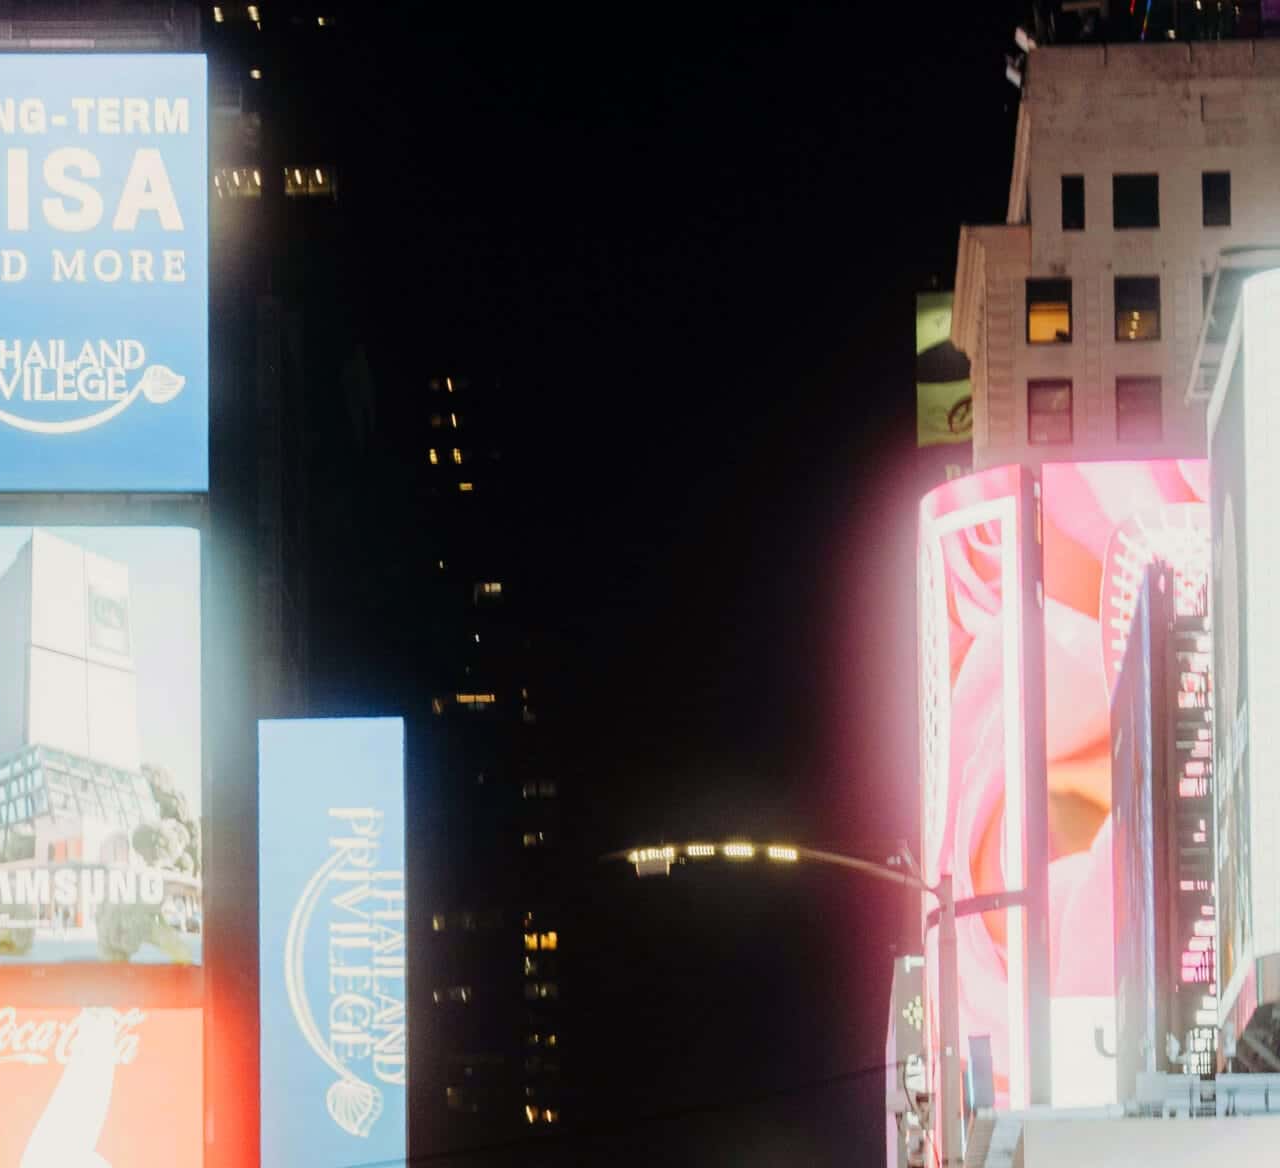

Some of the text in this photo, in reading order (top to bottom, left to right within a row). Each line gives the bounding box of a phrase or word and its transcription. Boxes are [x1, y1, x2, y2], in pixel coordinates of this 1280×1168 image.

[52, 249, 187, 283] MORE
[328, 806, 384, 1064] PRIVILEGE
[369, 868, 406, 1086] THAILAND
